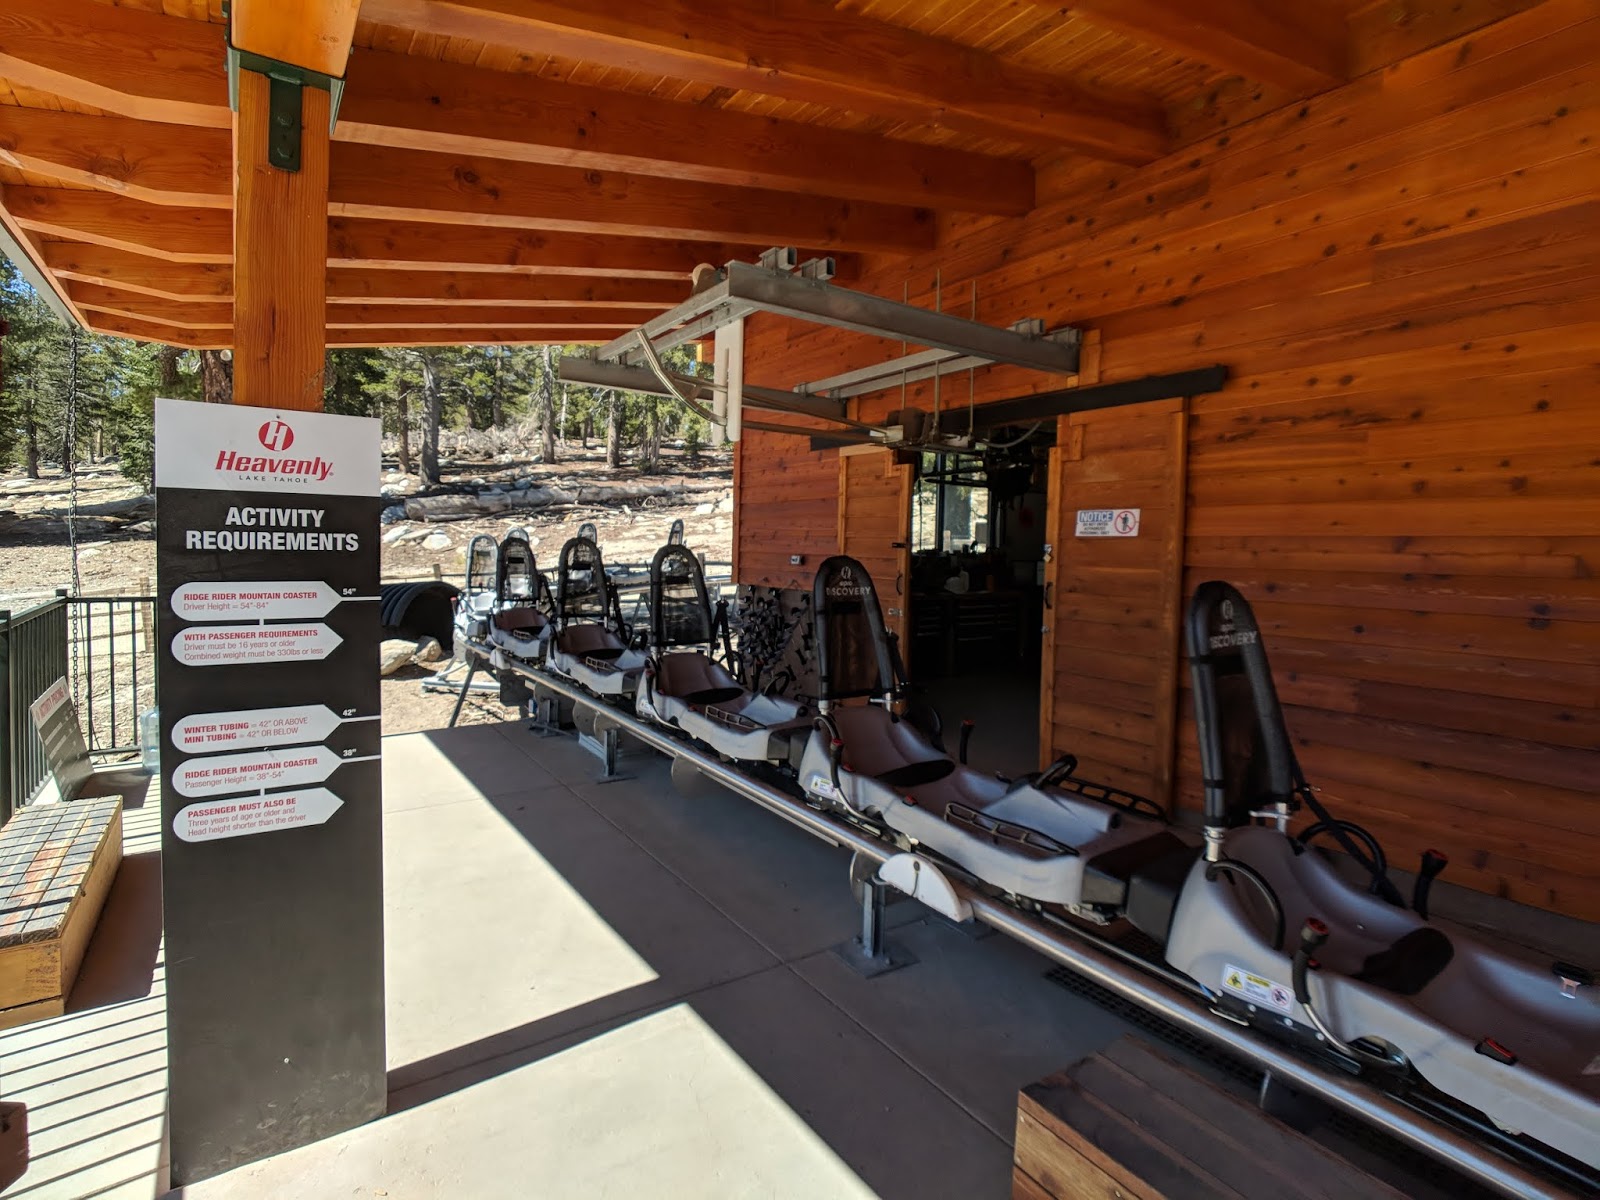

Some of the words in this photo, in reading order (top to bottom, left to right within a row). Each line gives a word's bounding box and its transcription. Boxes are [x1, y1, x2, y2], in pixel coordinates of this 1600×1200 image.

[215, 451, 333, 480] Heavenly
[225, 507, 324, 527] ACTIVITY
[1080, 511, 1113, 522] NOTICE
[186, 531, 359, 552] REQUIREMENTS
[184, 593, 209, 601] RIDGE
[239, 592, 280, 600] MOUNTAIN
[826, 586, 871, 596] DSCOVERY
[207, 602, 230, 611] Height
[184, 633, 206, 641] WITH
[208, 632, 256, 640] PASSENGER
[258, 630, 318, 639] REQUIREMENTS
[184, 652, 220, 660] Combined
[223, 651, 246, 660] weight
[266, 649, 275, 657] be
[277, 648, 300, 656] 330lbs
[250, 642, 268, 650] years
[184, 725, 216, 734] WINTER
[219, 723, 249, 731] TUBING
[259, 720, 271, 728] 42"
[285, 717, 308, 725] ABOVE
[184, 735, 203, 744] MINI
[207, 733, 237, 742] TUBING
[247, 730, 259, 738] 42"
[261, 729, 272, 737] OR
[273, 727, 298, 736] BELOW
[185, 771, 210, 779] RIDGE
[213, 767, 237, 776] RIDER
[240, 763, 281, 773] MOUNTAIN
[283, 758, 317, 768] COASTER
[185, 779, 222, 789] Passenger
[225, 775, 247, 785] Height
[256, 770, 284, 780] 38"-54"
[188, 806, 236, 818] PASSENGER
[239, 803, 261, 811] MUST
[263, 799, 284, 808] ALSO
[188, 818, 208, 827] Three
[211, 817, 229, 826] years
[240, 814, 252, 822] age
[264, 809, 280, 817] older
[188, 828, 206, 836] Head
[209, 825, 230, 835] height
[232, 821, 256, 830] shorter
[258, 818, 273, 826] than
[288, 814, 306, 823] driver
